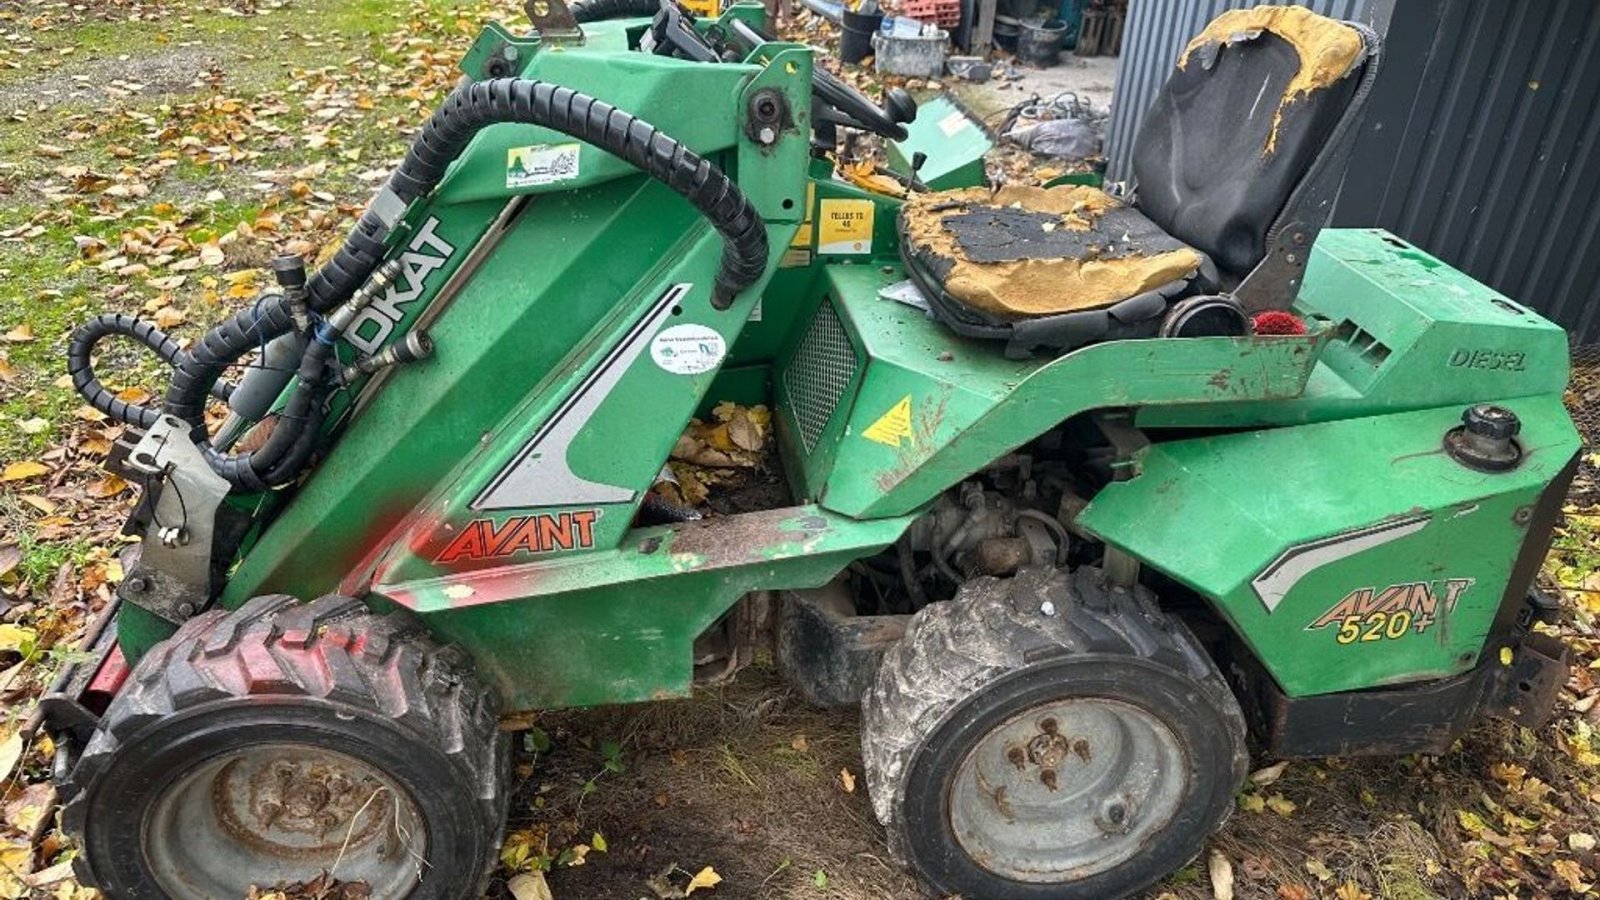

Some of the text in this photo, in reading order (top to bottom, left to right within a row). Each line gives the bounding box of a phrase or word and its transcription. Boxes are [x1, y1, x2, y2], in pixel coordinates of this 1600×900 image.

[1447, 349, 1526, 371] DIESEL
[432, 510, 596, 564] AVANT
[1304, 578, 1475, 630] AVANT
